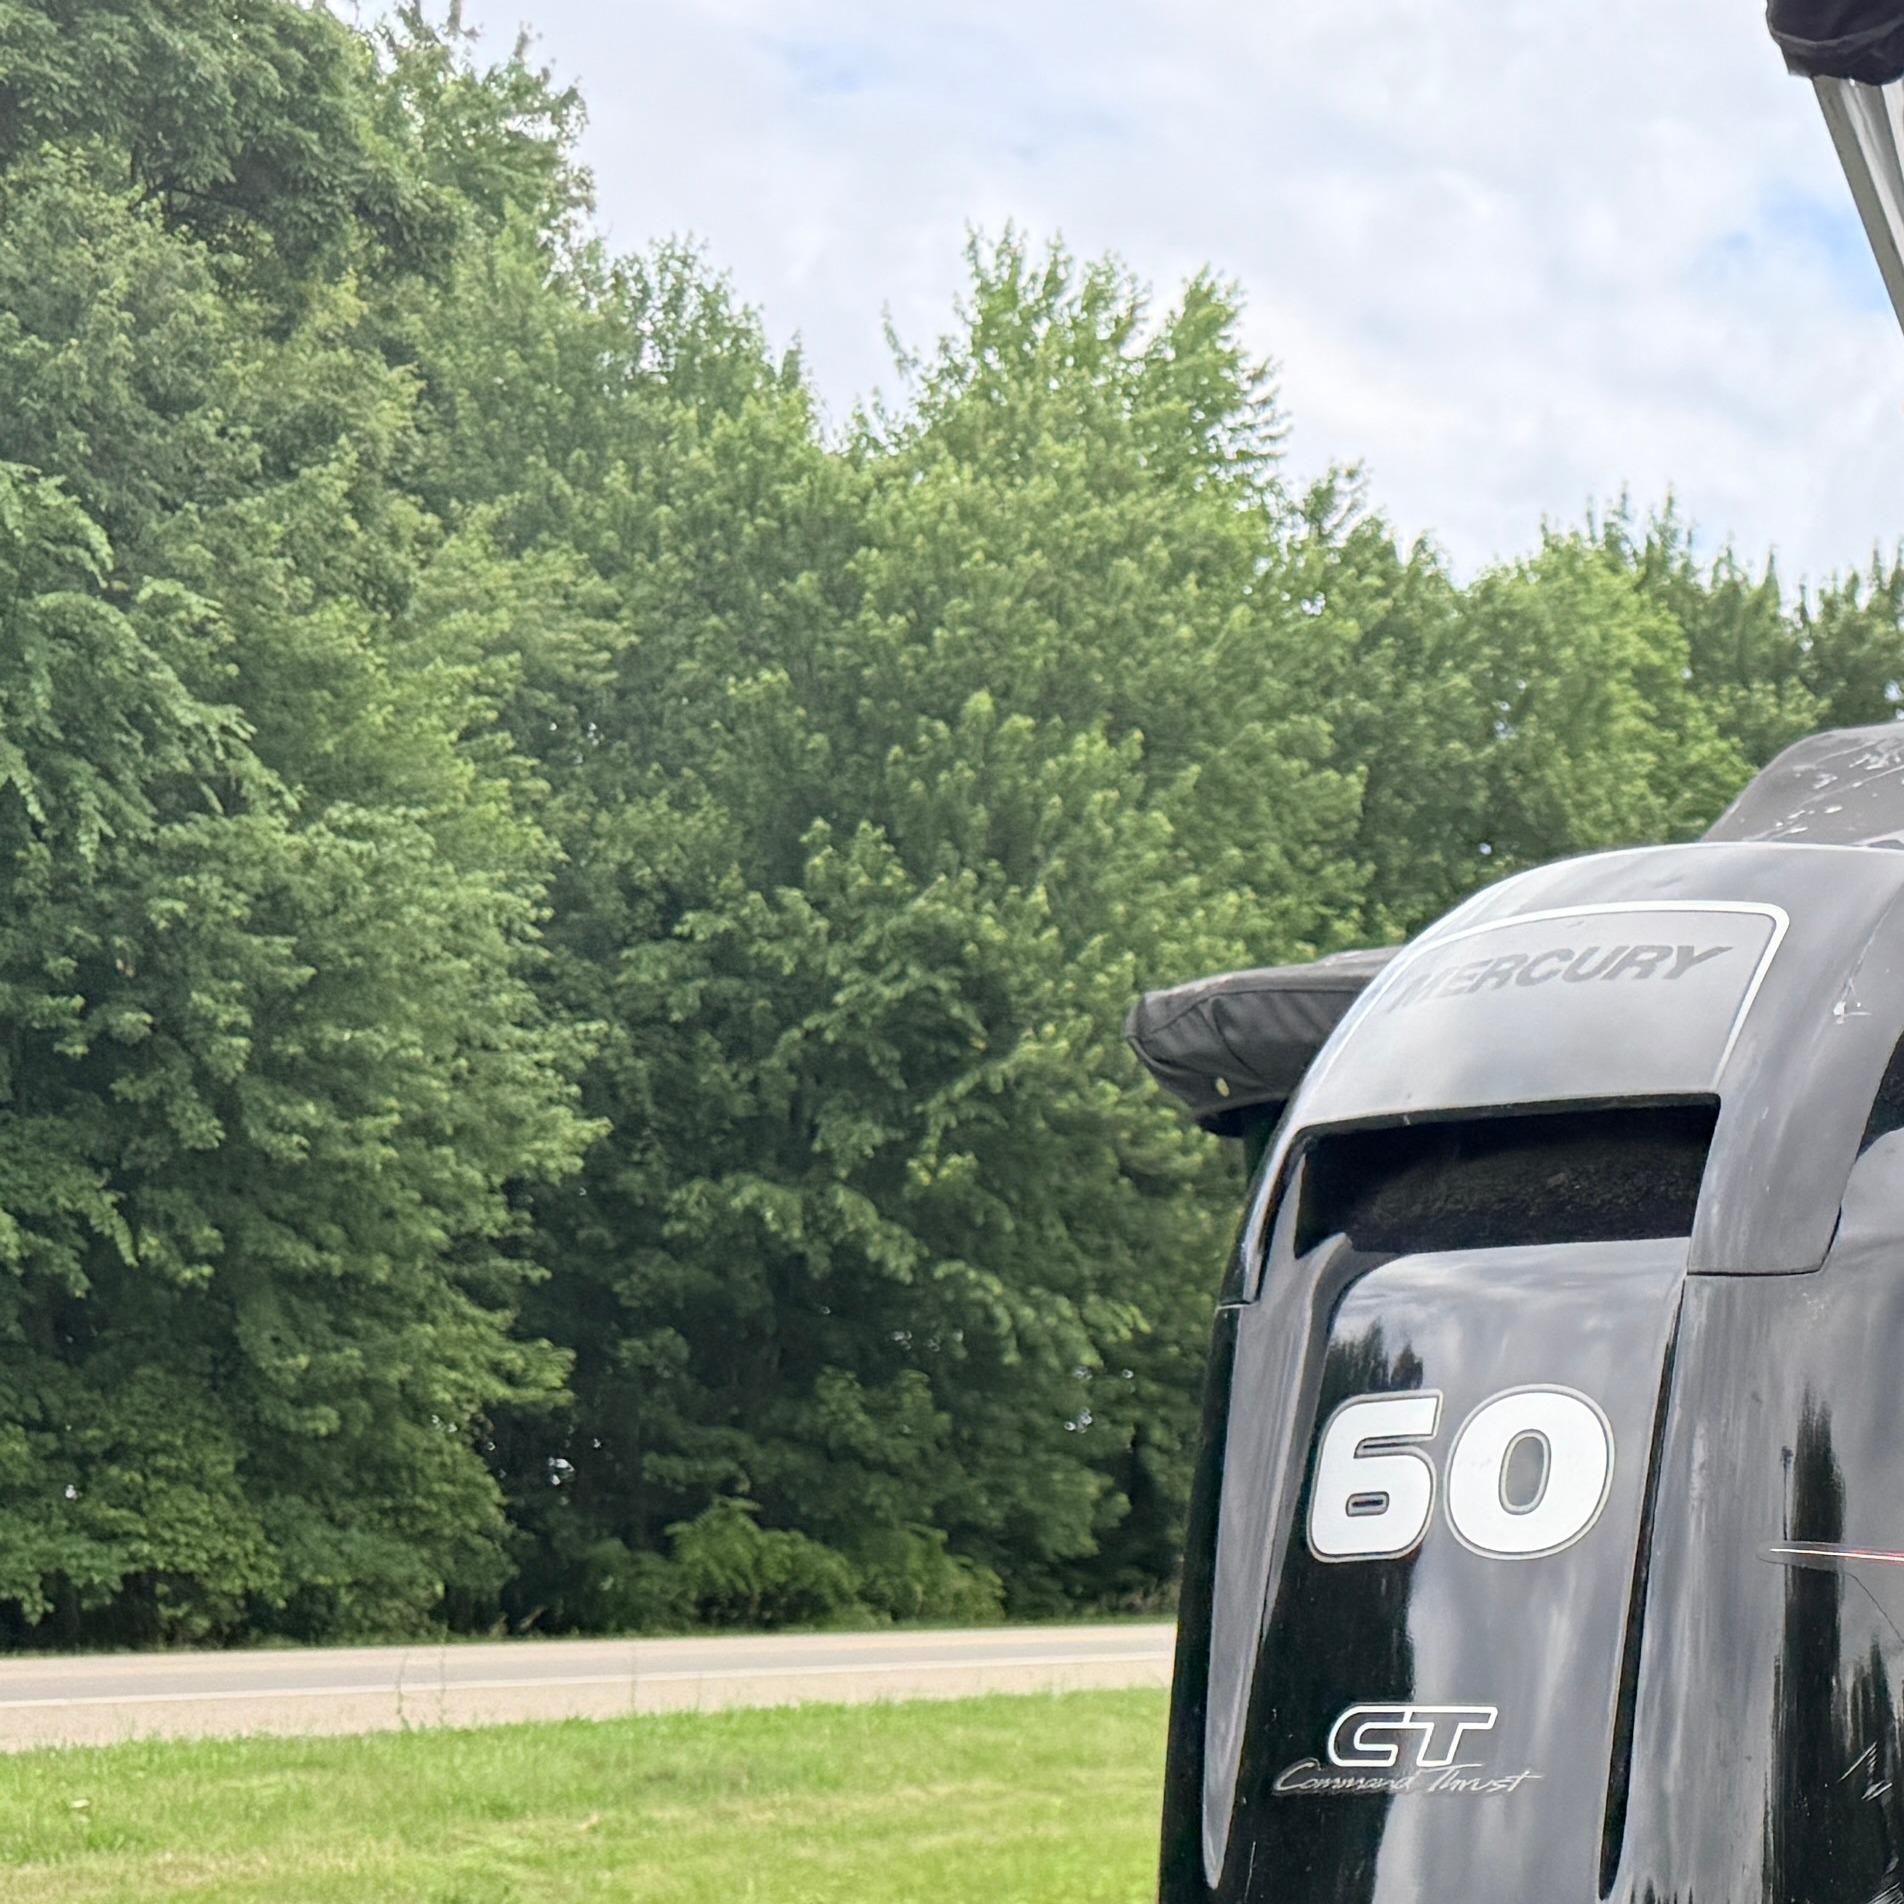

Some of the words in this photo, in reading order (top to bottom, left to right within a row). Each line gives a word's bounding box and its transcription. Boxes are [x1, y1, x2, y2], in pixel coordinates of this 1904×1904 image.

[1387, 944, 1735, 1015] MERCURY
[1307, 1383, 1616, 1563] 60
[1421, 1762, 1543, 1794] Thrust
